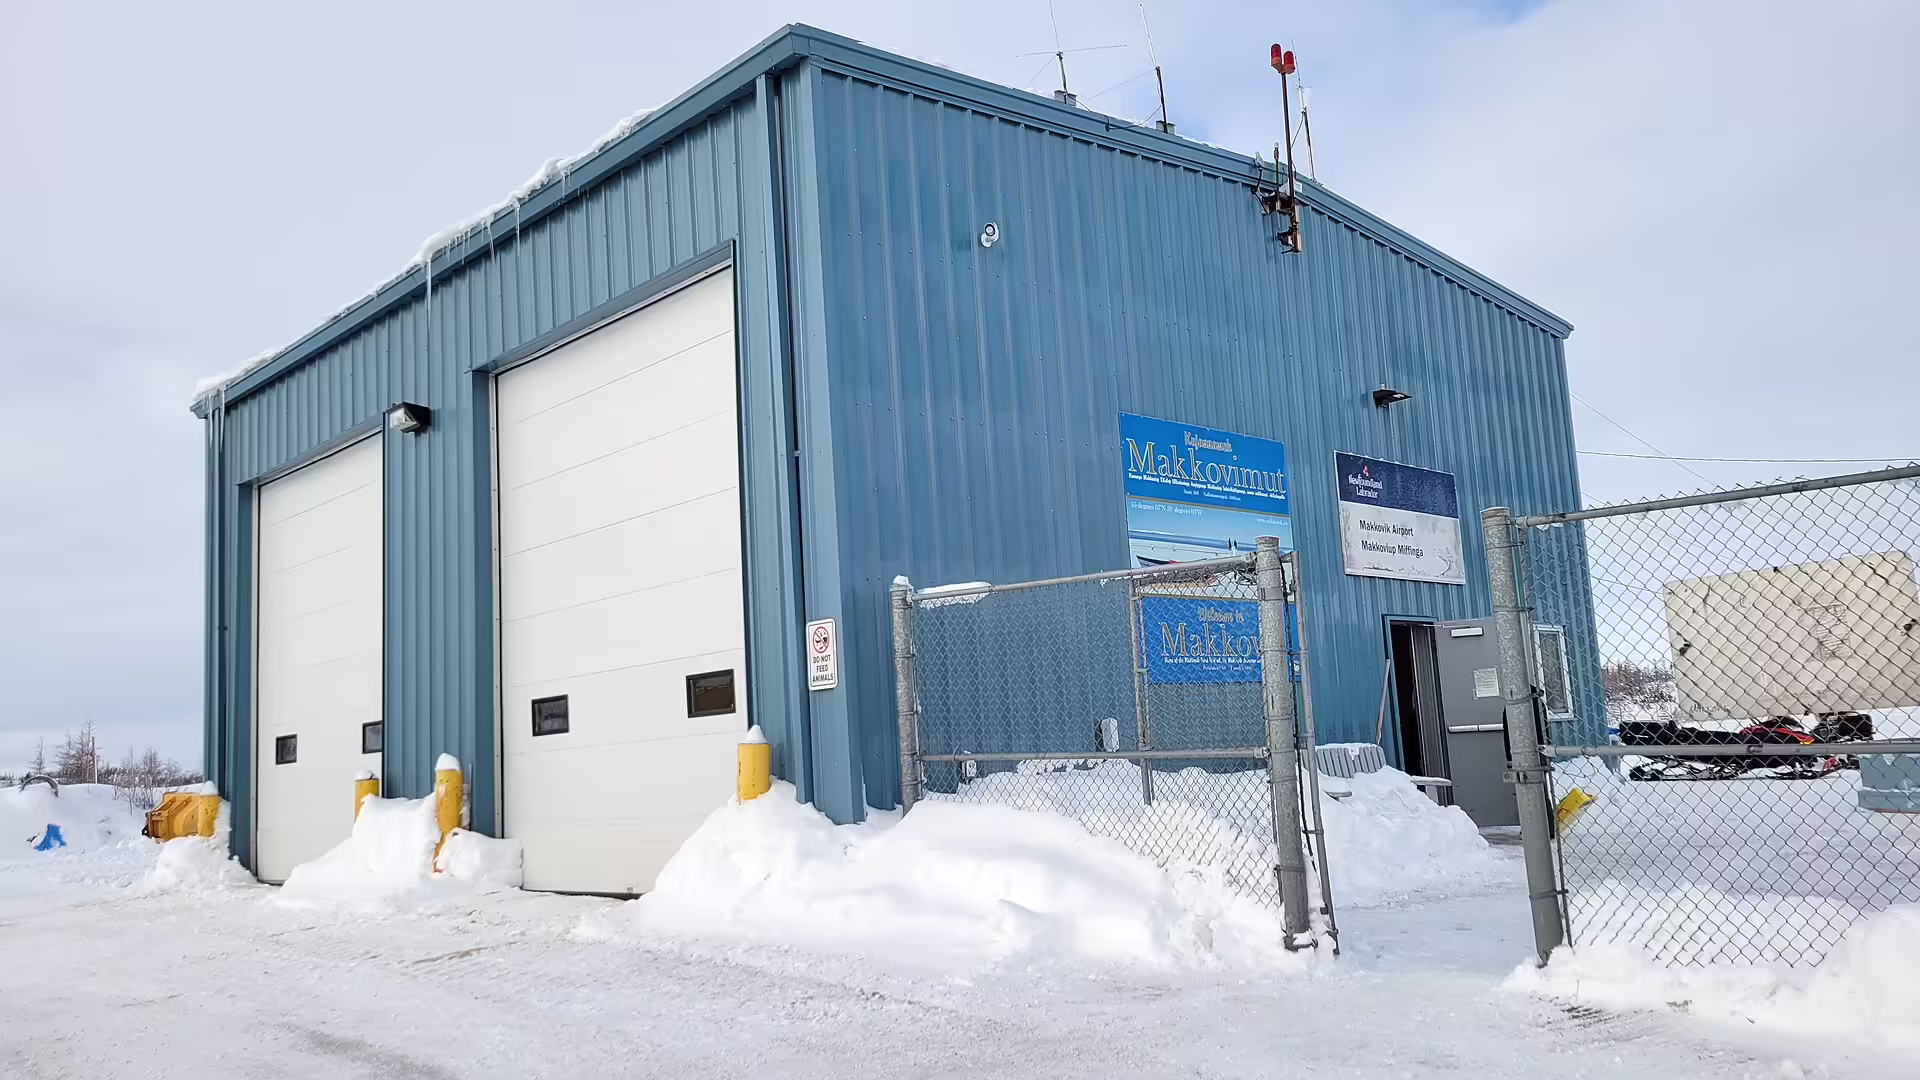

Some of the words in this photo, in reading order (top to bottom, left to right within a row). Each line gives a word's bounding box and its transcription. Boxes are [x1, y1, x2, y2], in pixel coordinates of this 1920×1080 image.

[1126, 438, 1287, 494] Makkovimut
[1348, 474, 1383, 489] Newfoundland
[1356, 485, 1378, 498] Labrador
[1360, 520, 1391, 534] Makkovik
[1392, 524, 1414, 537] Airport
[1361, 540, 1397, 556] Makkoviup
[1398, 544, 1424, 558] Miffinga
[1158, 621, 1263, 657] Makkov
[821, 654, 831, 662] NOT
[816, 664, 828, 673] FEED
[812, 673, 834, 683] ANIMALS
